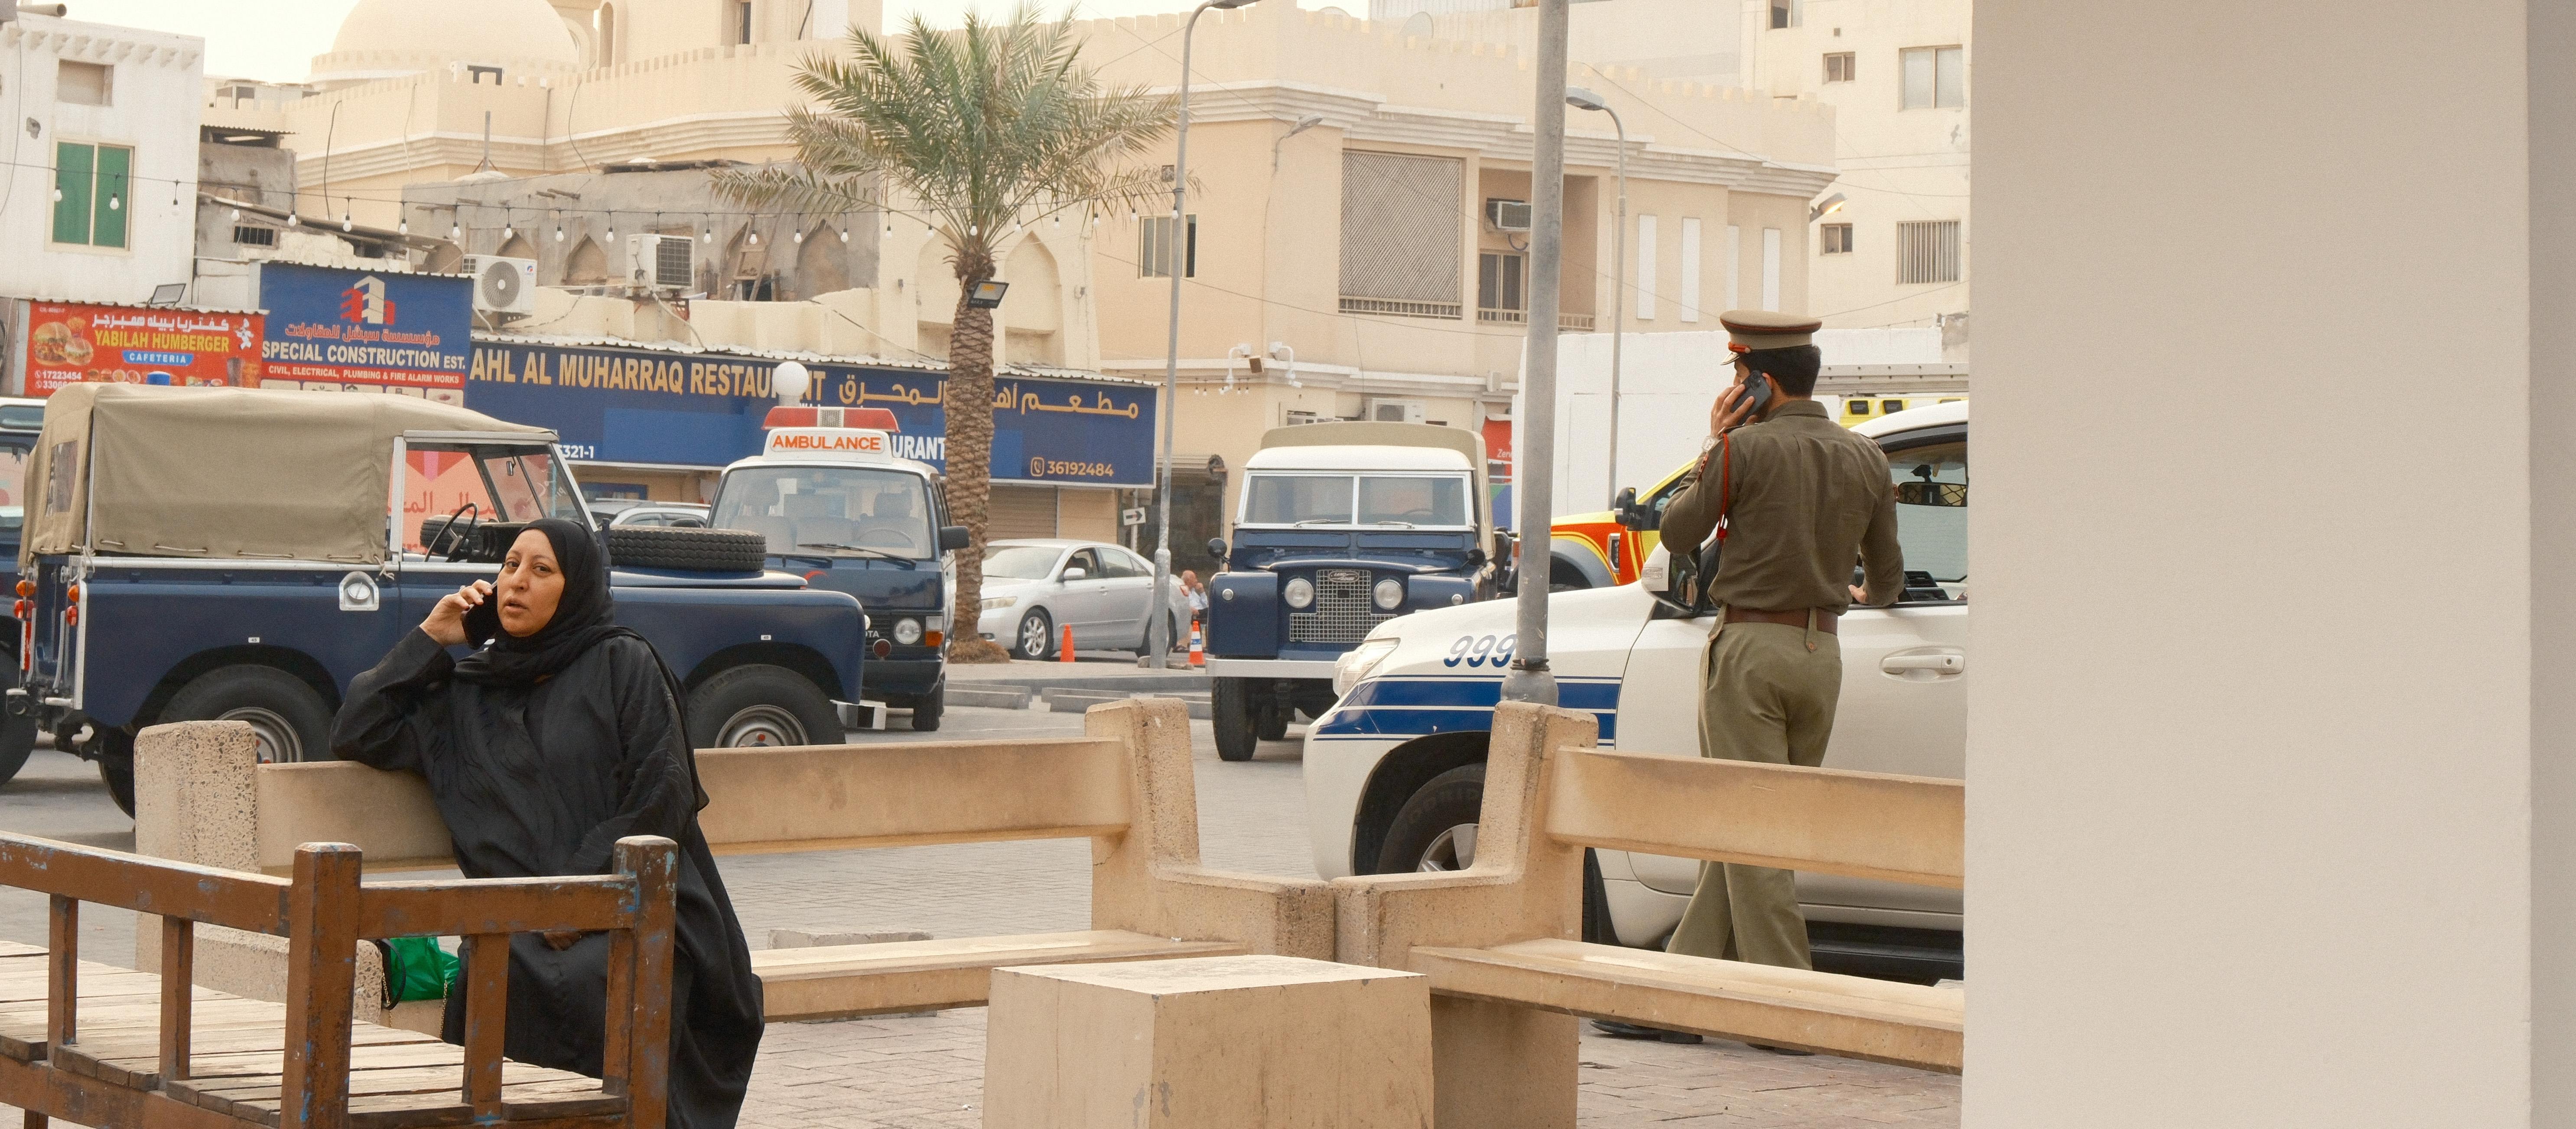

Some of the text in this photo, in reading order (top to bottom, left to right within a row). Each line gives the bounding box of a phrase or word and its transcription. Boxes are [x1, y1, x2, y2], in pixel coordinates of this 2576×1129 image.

[94, 329, 229, 352] YABILAH HUMBERGER
[129, 352, 186, 363] CAFETERIA
[261, 341, 465, 370] SPECIAL CONSTRUCTION EST.
[269, 365, 290, 376] CIVIL,
[293, 367, 339, 379] ELECTRICAL,
[343, 370, 381, 380] PLUMBING
[390, 372, 406, 381] FIRE
[407, 374, 432, 382] ALARM
[434, 374, 459, 383] WORKS
[469, 348, 826, 401] AHL AL MUHARRAQ RESTAUT
[1021, 391, 1139, 419] مطعم
[772, 435, 881, 450] AMBULANCE
[1047, 461, 1114, 477] 36192484
[1444, 634, 1518, 668] 999
